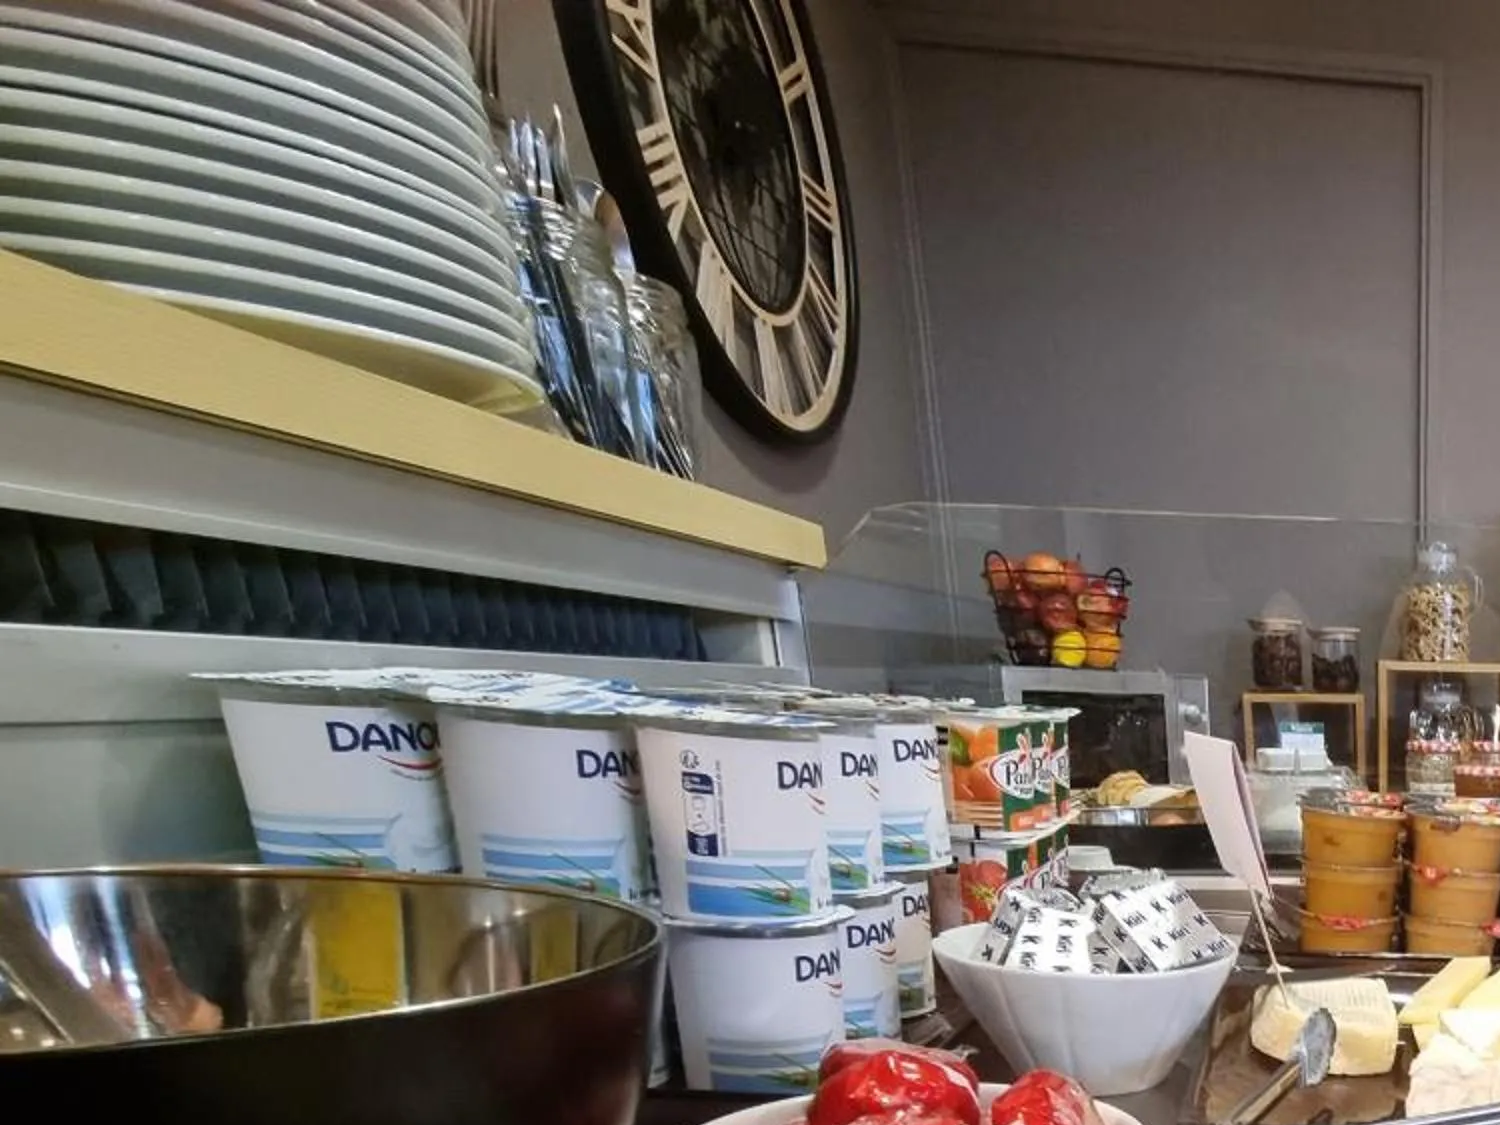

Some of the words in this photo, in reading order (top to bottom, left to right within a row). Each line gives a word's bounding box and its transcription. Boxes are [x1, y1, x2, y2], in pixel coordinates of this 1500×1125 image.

[326, 720, 441, 752] DANO
[893, 739, 939, 762] DAN
[1150, 900, 1168, 914] K
[1058, 918, 1080, 929] K
[1122, 910, 1147, 928] Kiri
[1193, 912, 1209, 927] K
[1022, 934, 1042, 945] K
[1114, 927, 1128, 943] K
[1167, 926, 1192, 941] Kiri
[1091, 946, 1110, 956] K
[1151, 937, 1169, 951] K
